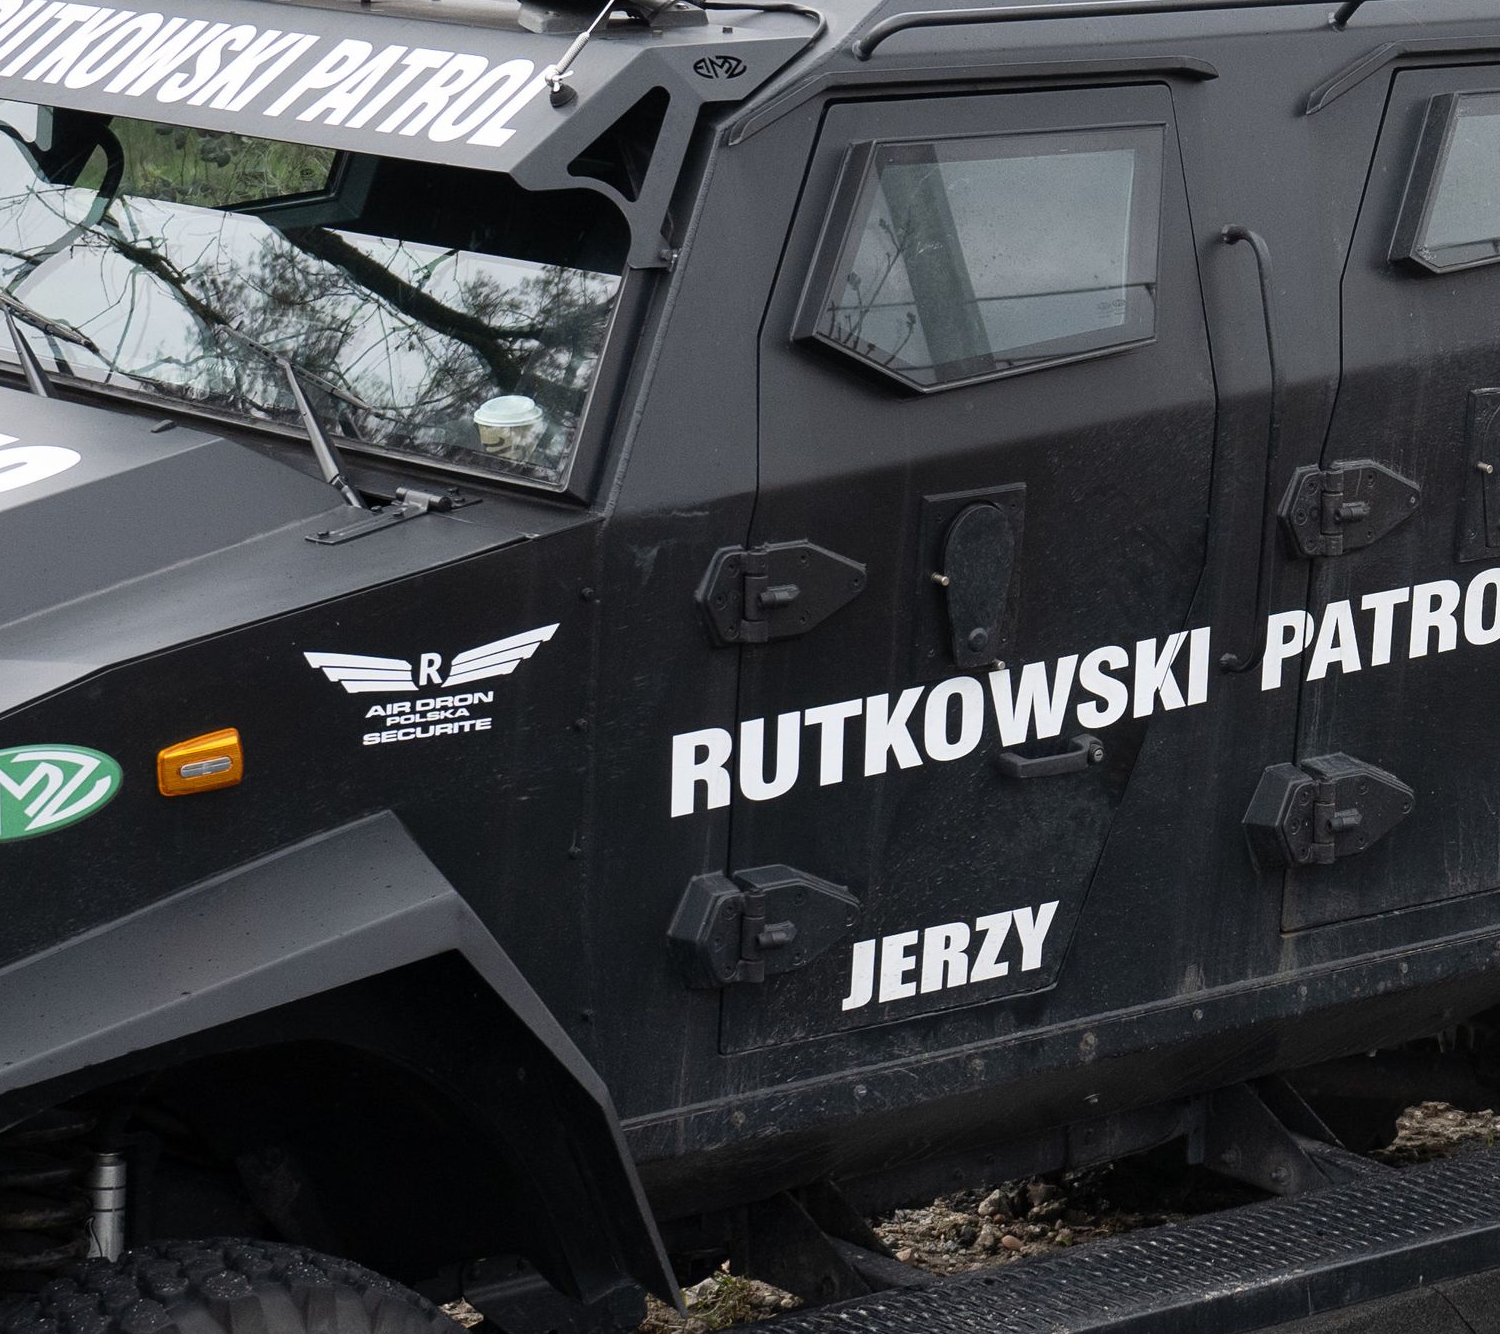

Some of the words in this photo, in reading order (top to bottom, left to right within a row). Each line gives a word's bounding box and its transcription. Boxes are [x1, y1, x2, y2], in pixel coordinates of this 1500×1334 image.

[262, 38, 556, 148] PATROL
[418, 652, 443, 686] R
[365, 701, 412, 718] AIR
[416, 691, 494, 712] DRON
[386, 708, 470, 727] POLSKA
[362, 718, 493, 746] SECURITE
[670, 626, 1211, 818] RUTKOWSKI
[841, 900, 1060, 1012] JERZY
